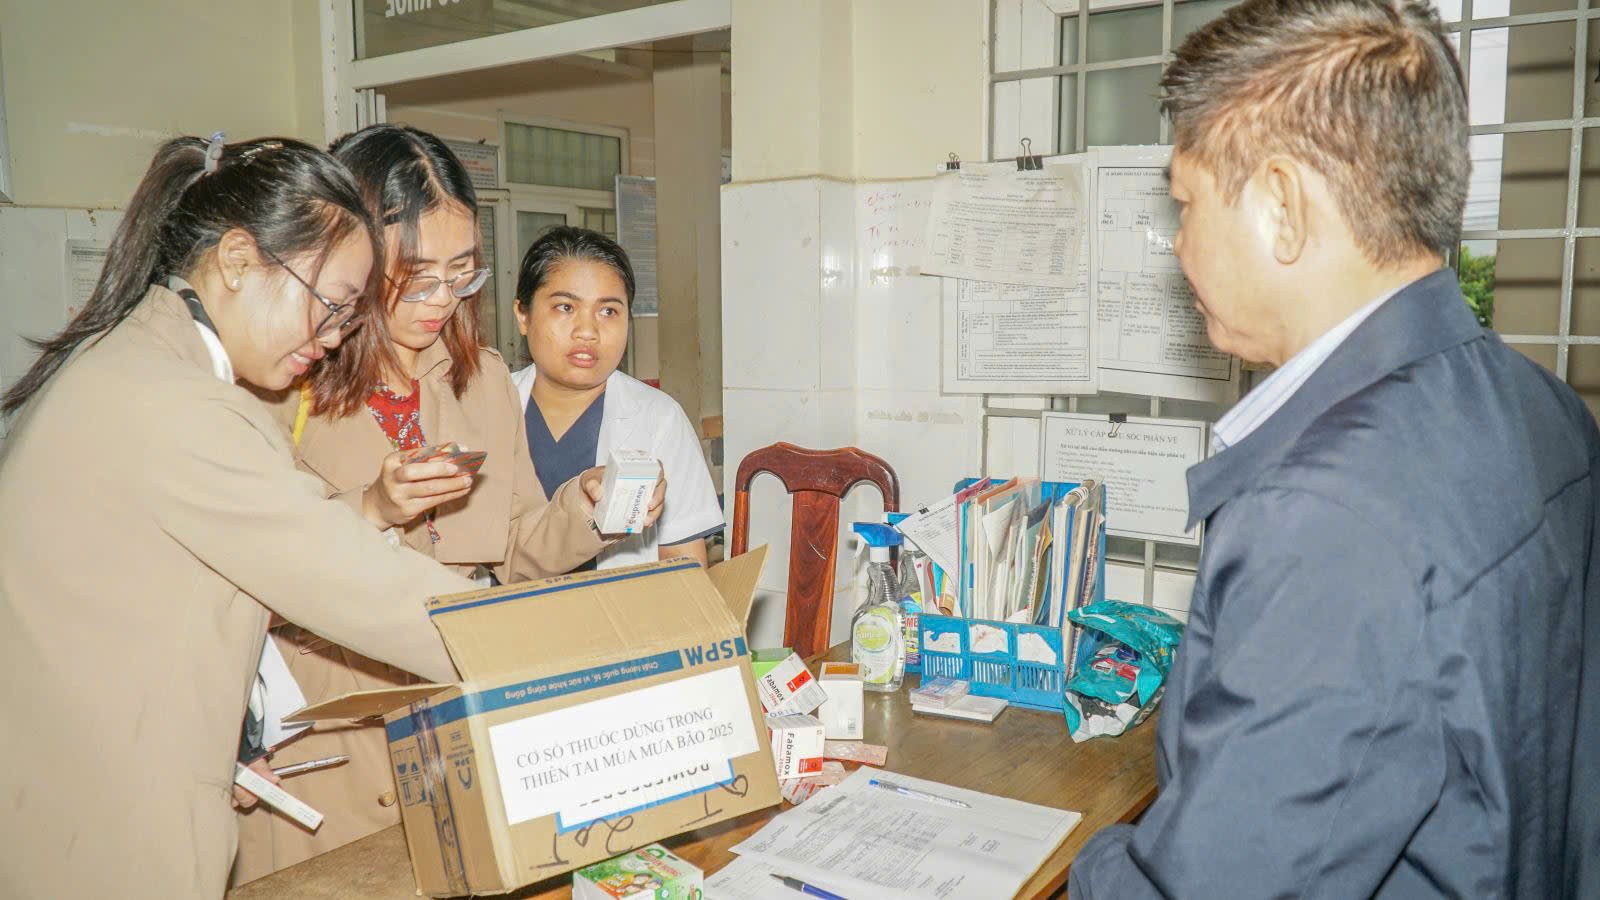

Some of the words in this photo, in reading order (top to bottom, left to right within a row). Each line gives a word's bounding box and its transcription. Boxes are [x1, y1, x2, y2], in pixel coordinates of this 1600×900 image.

[684, 638, 735, 667] SPM
[765, 674, 785, 702] Fabamox
[516, 751, 540, 769] CƠ
[543, 743, 565, 763] SỐ
[567, 729, 620, 756] THUỐC
[623, 717, 664, 741] DÙNG
[666, 707, 713, 730] TRONG
[520, 766, 570, 791] THIÊN
[574, 758, 598, 778] TAI
[602, 748, 638, 769] MÙA
[640, 738, 674, 759] MƯA
[677, 729, 705, 750] BÃO
[709, 722, 735, 741] 2025
[784, 732, 795, 775] Fabamox
